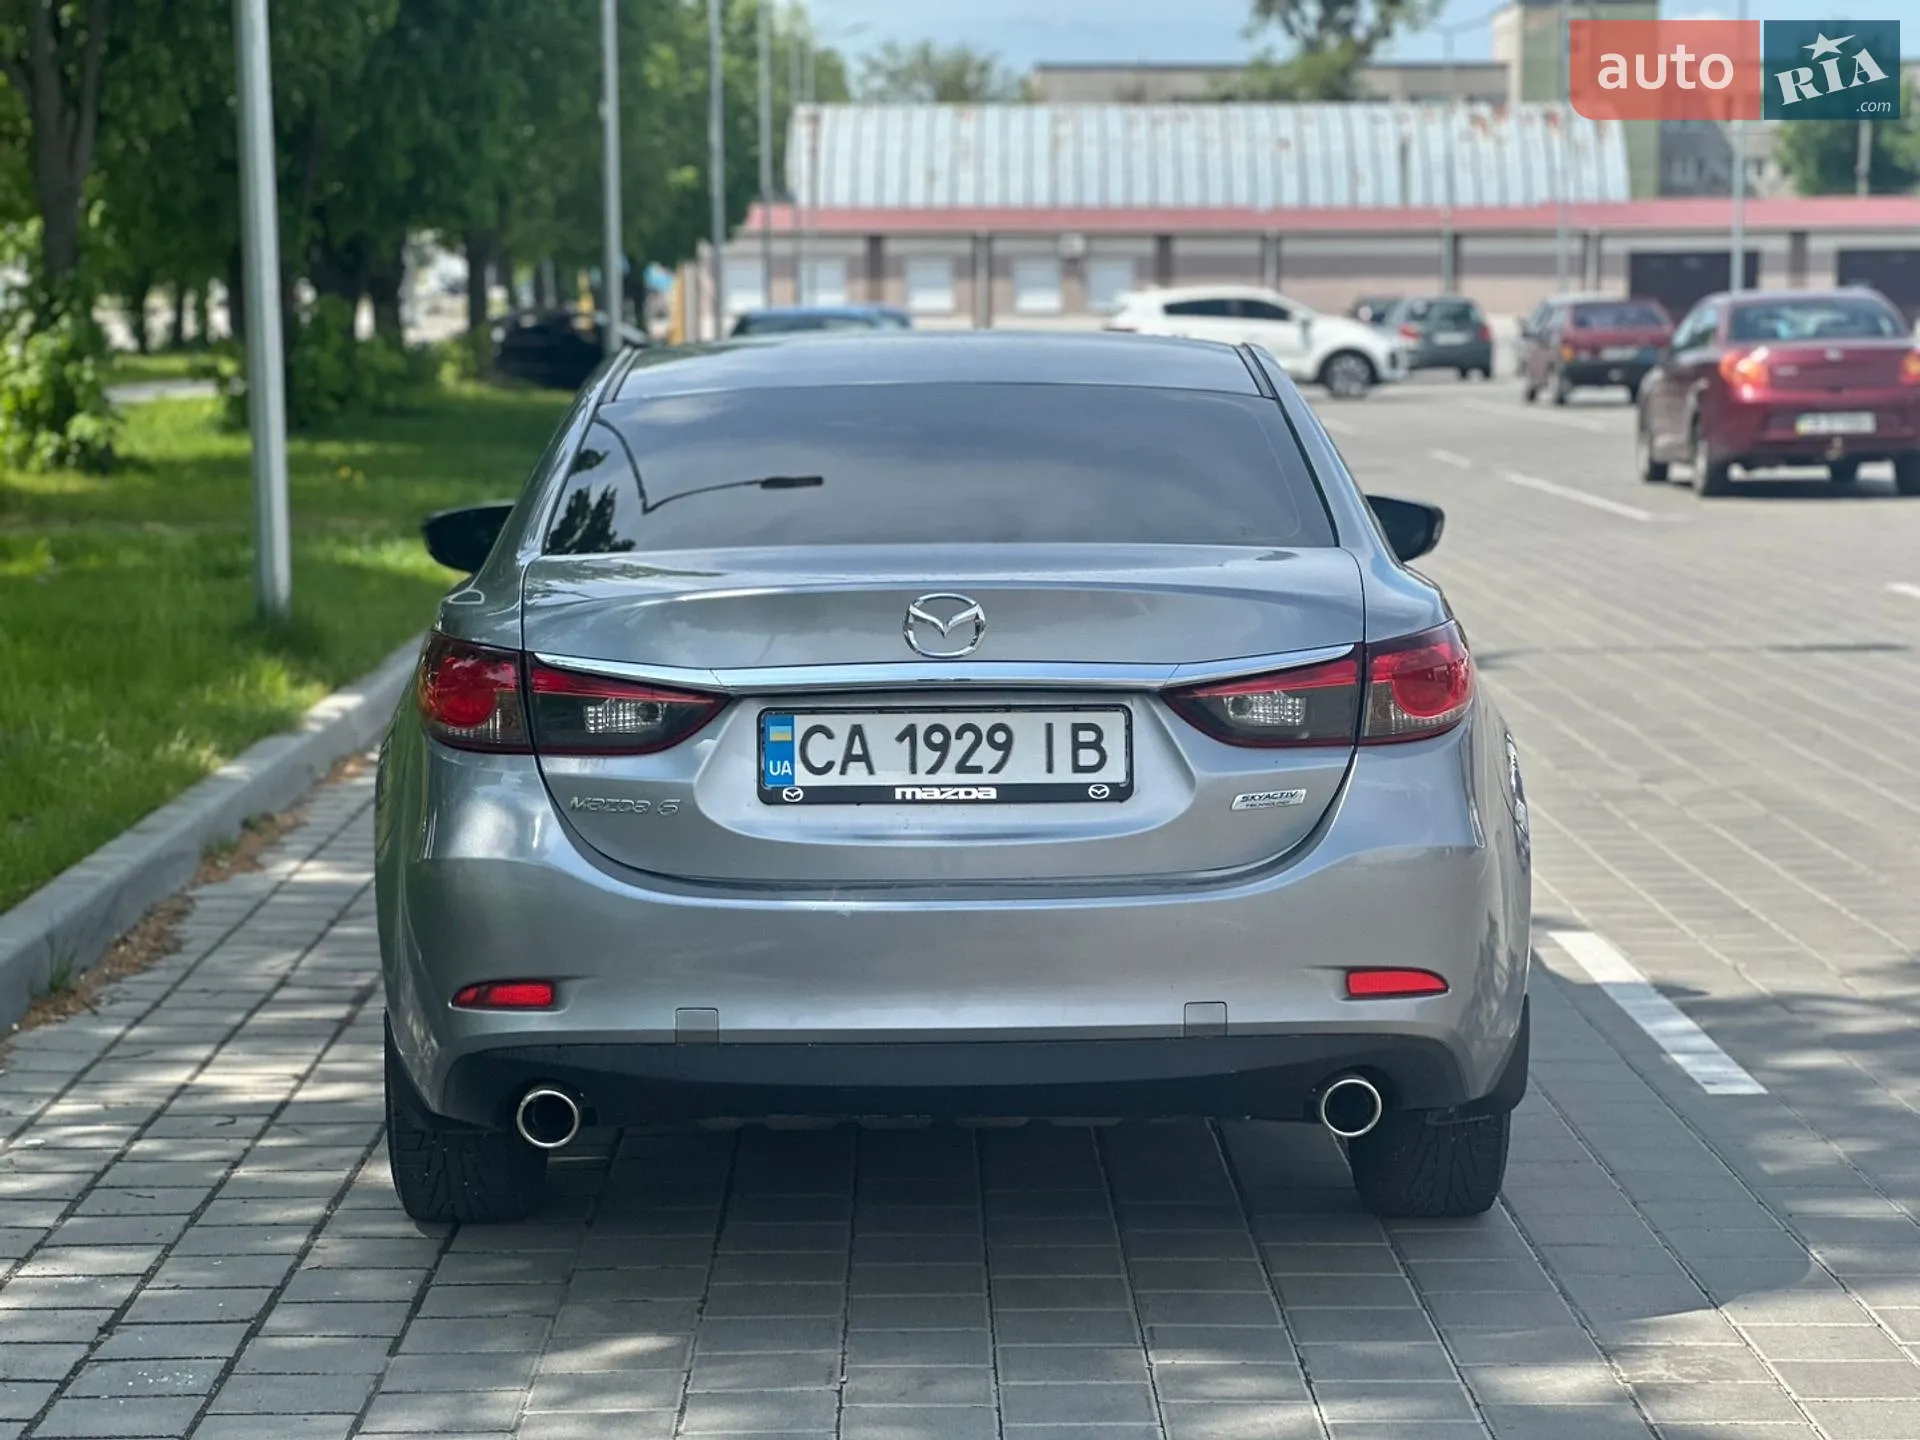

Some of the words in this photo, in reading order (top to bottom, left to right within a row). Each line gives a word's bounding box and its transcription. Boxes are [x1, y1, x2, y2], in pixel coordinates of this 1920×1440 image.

[799, 723, 876, 777] CA
[894, 722, 1015, 776] 1929
[1044, 722, 1108, 775] IB
[769, 760, 792, 776] UA
[1240, 791, 1298, 803] SKYACTIV
[657, 799, 680, 815] 6
